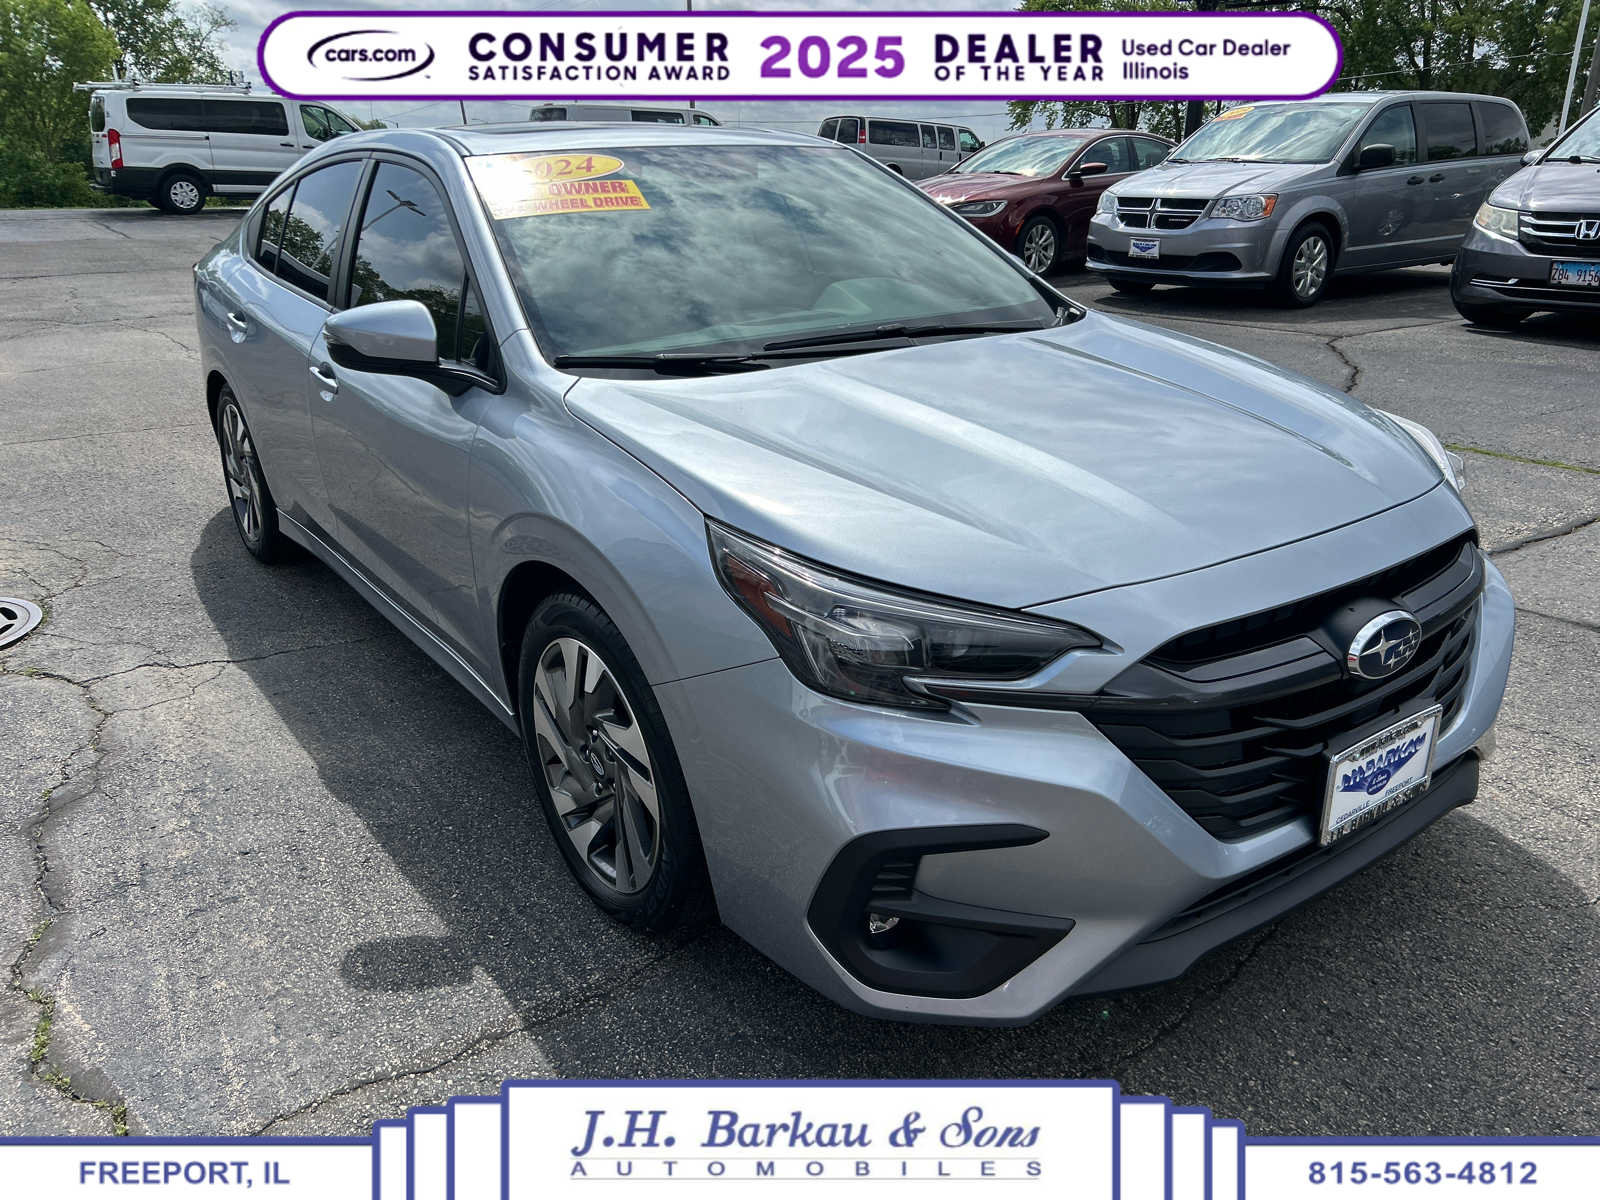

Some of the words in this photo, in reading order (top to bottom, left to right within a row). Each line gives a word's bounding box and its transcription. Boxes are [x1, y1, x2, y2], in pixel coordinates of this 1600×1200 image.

[534, 156, 595, 177] 024
[534, 198, 590, 212] WHEEL
[592, 196, 642, 208] DRIVE
